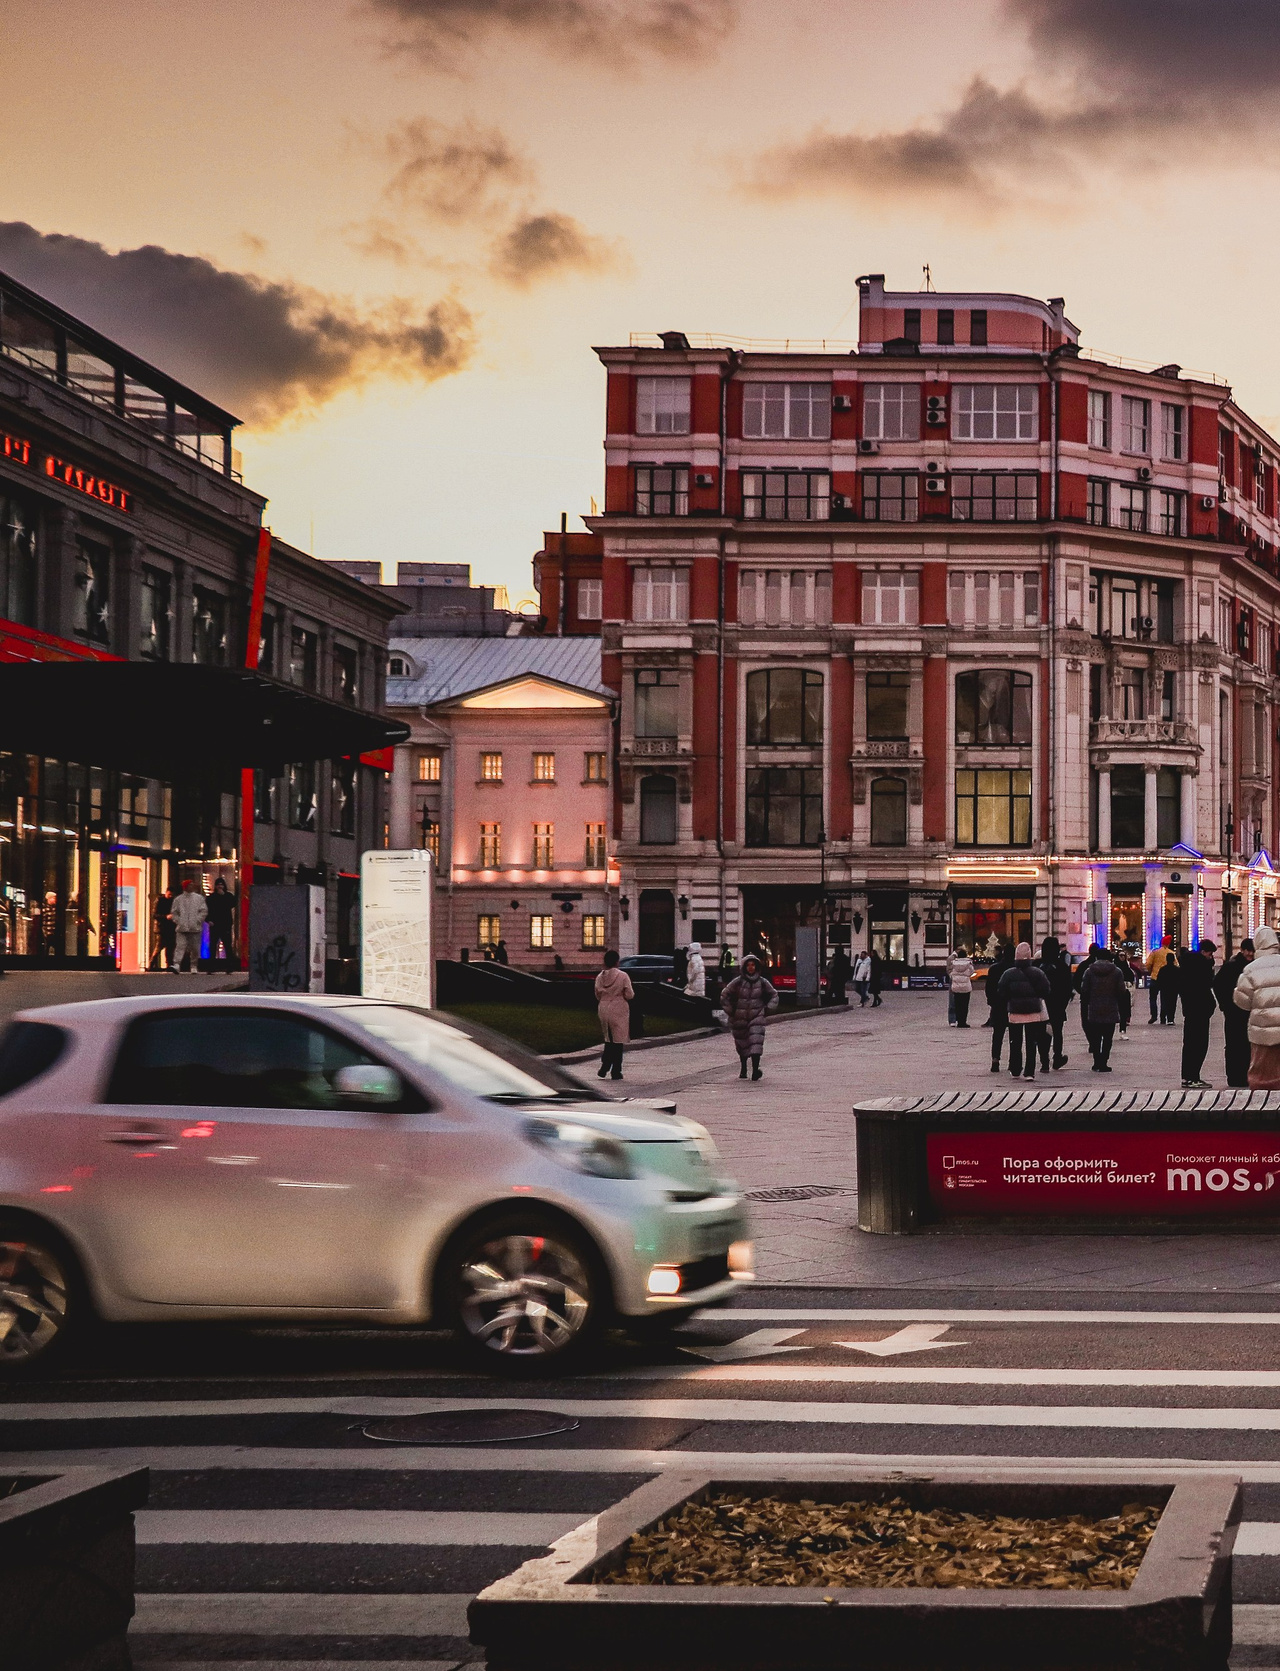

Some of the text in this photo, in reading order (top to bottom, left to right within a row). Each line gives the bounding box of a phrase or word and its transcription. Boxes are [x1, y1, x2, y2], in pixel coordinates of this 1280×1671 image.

[1003, 1156, 1118, 1171] Пора оформить
[1166, 1153, 1216, 1163] Поможет
[1219, 1153, 1259, 1163] личный
[1003, 1171, 1156, 1183] читательский билет?
